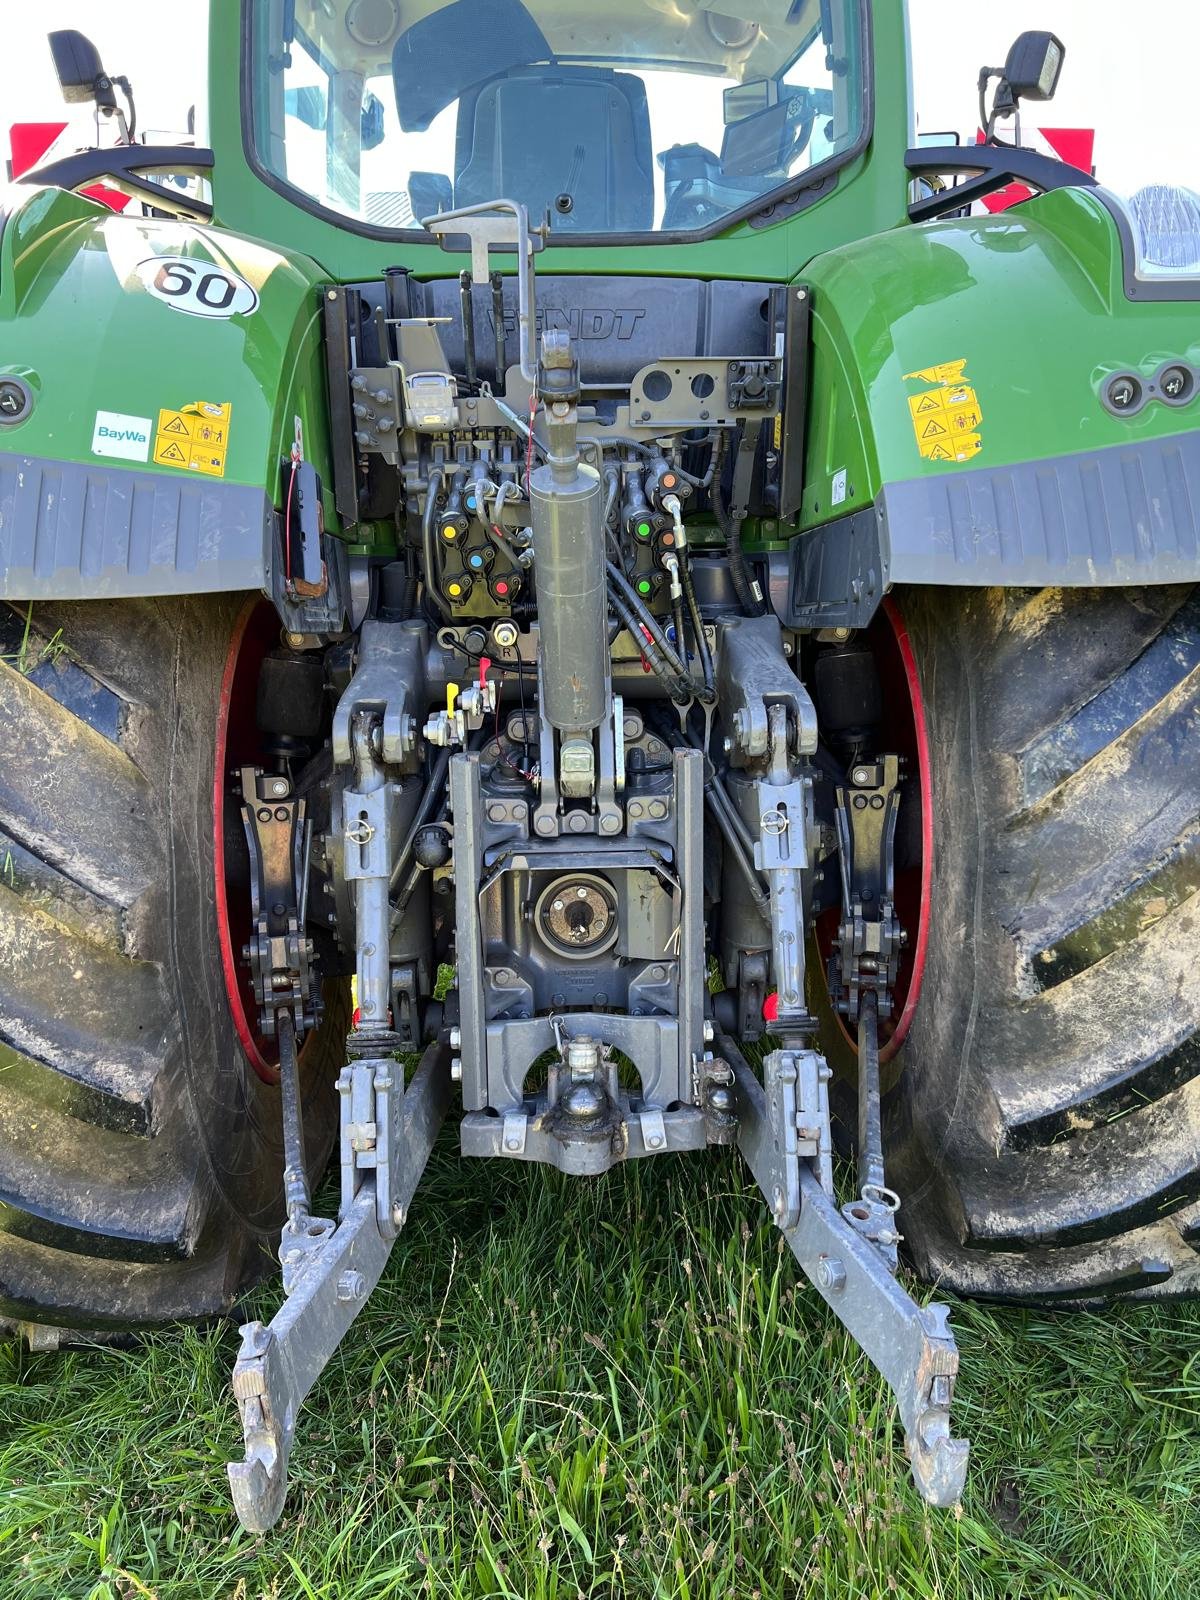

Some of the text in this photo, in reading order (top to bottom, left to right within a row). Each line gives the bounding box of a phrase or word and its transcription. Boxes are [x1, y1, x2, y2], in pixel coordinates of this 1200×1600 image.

[153, 262, 237, 309] 60
[98, 426, 147, 443] BayWa
[503, 648, 511, 657] R
